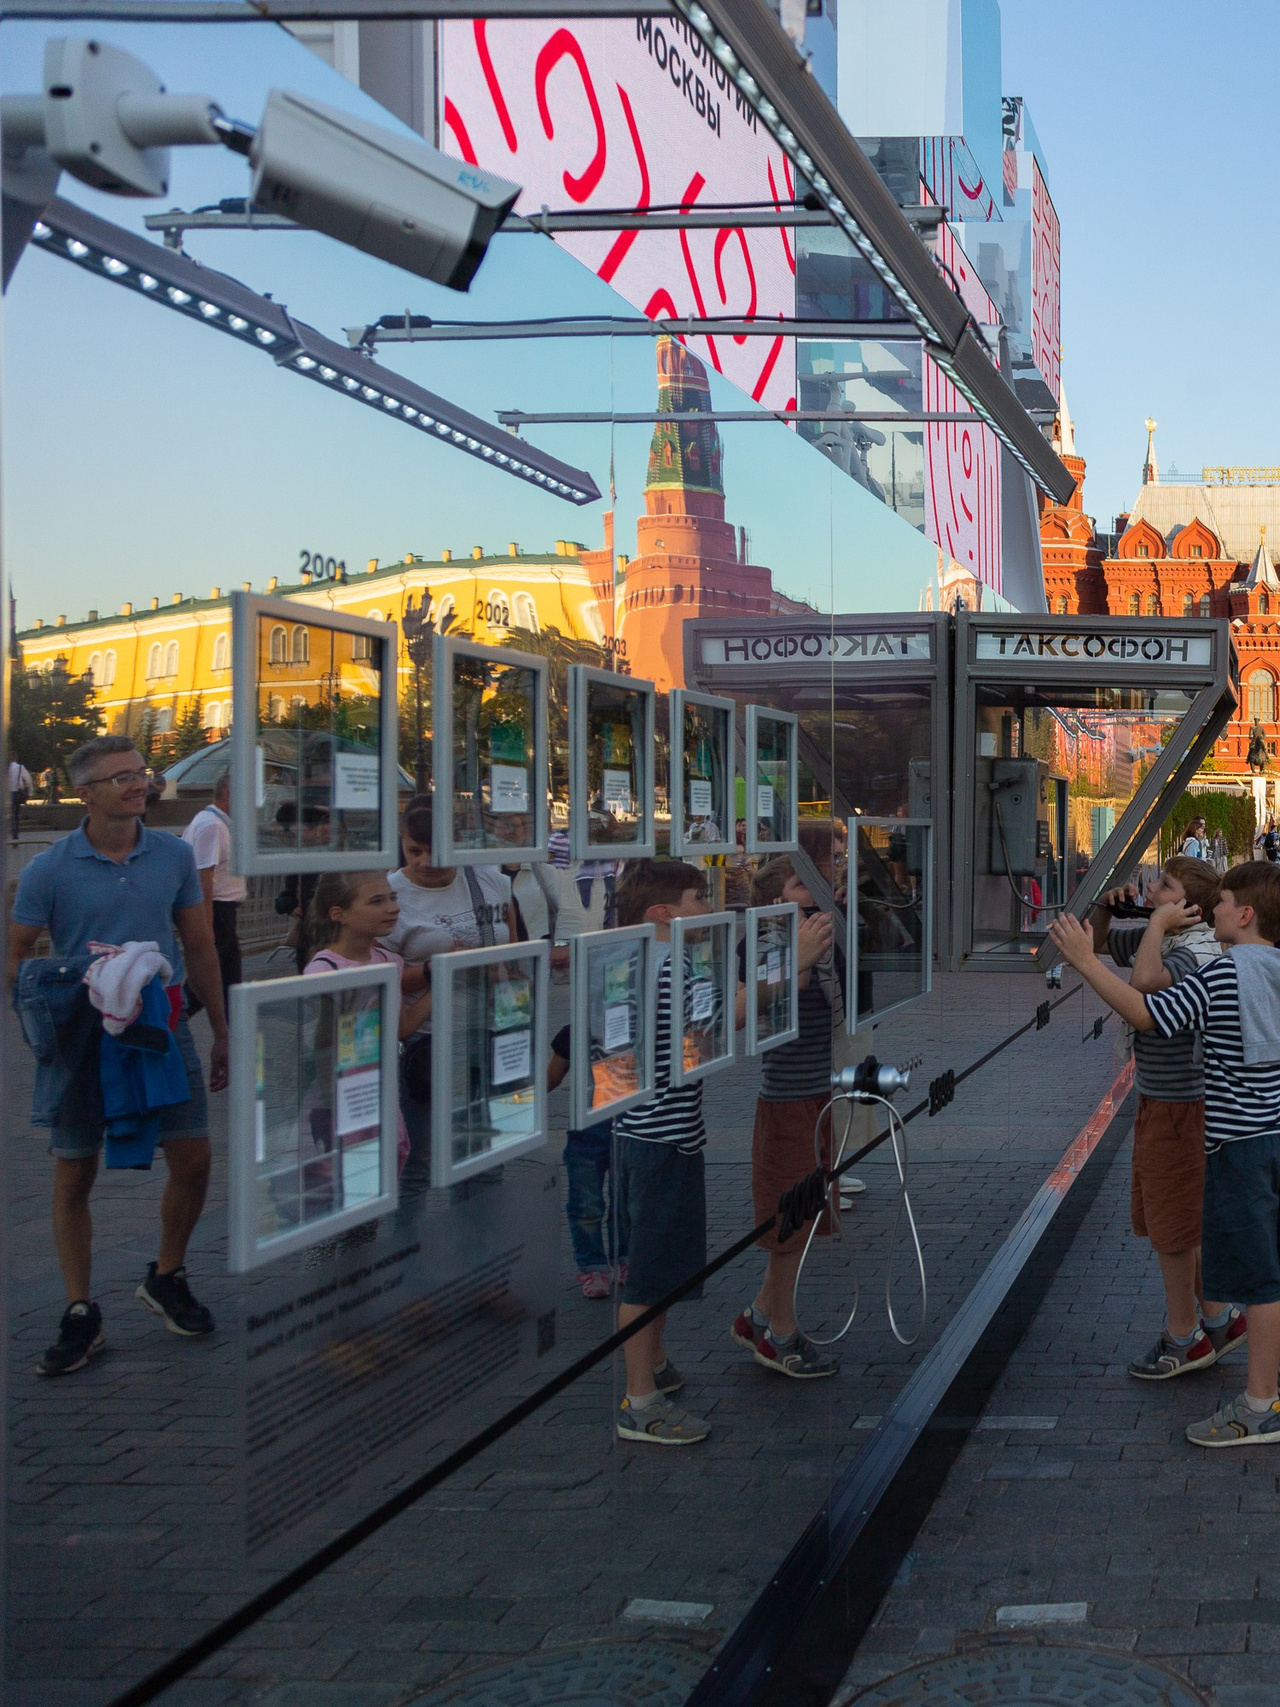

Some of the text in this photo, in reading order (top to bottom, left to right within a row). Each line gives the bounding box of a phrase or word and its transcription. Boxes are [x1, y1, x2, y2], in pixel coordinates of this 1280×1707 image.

[636, 17, 721, 138] МОСКВЫ
[299, 549, 347, 584] 2001
[476, 600, 509, 627] 2002
[992, 632, 1188, 661] ТАКСОФОН
